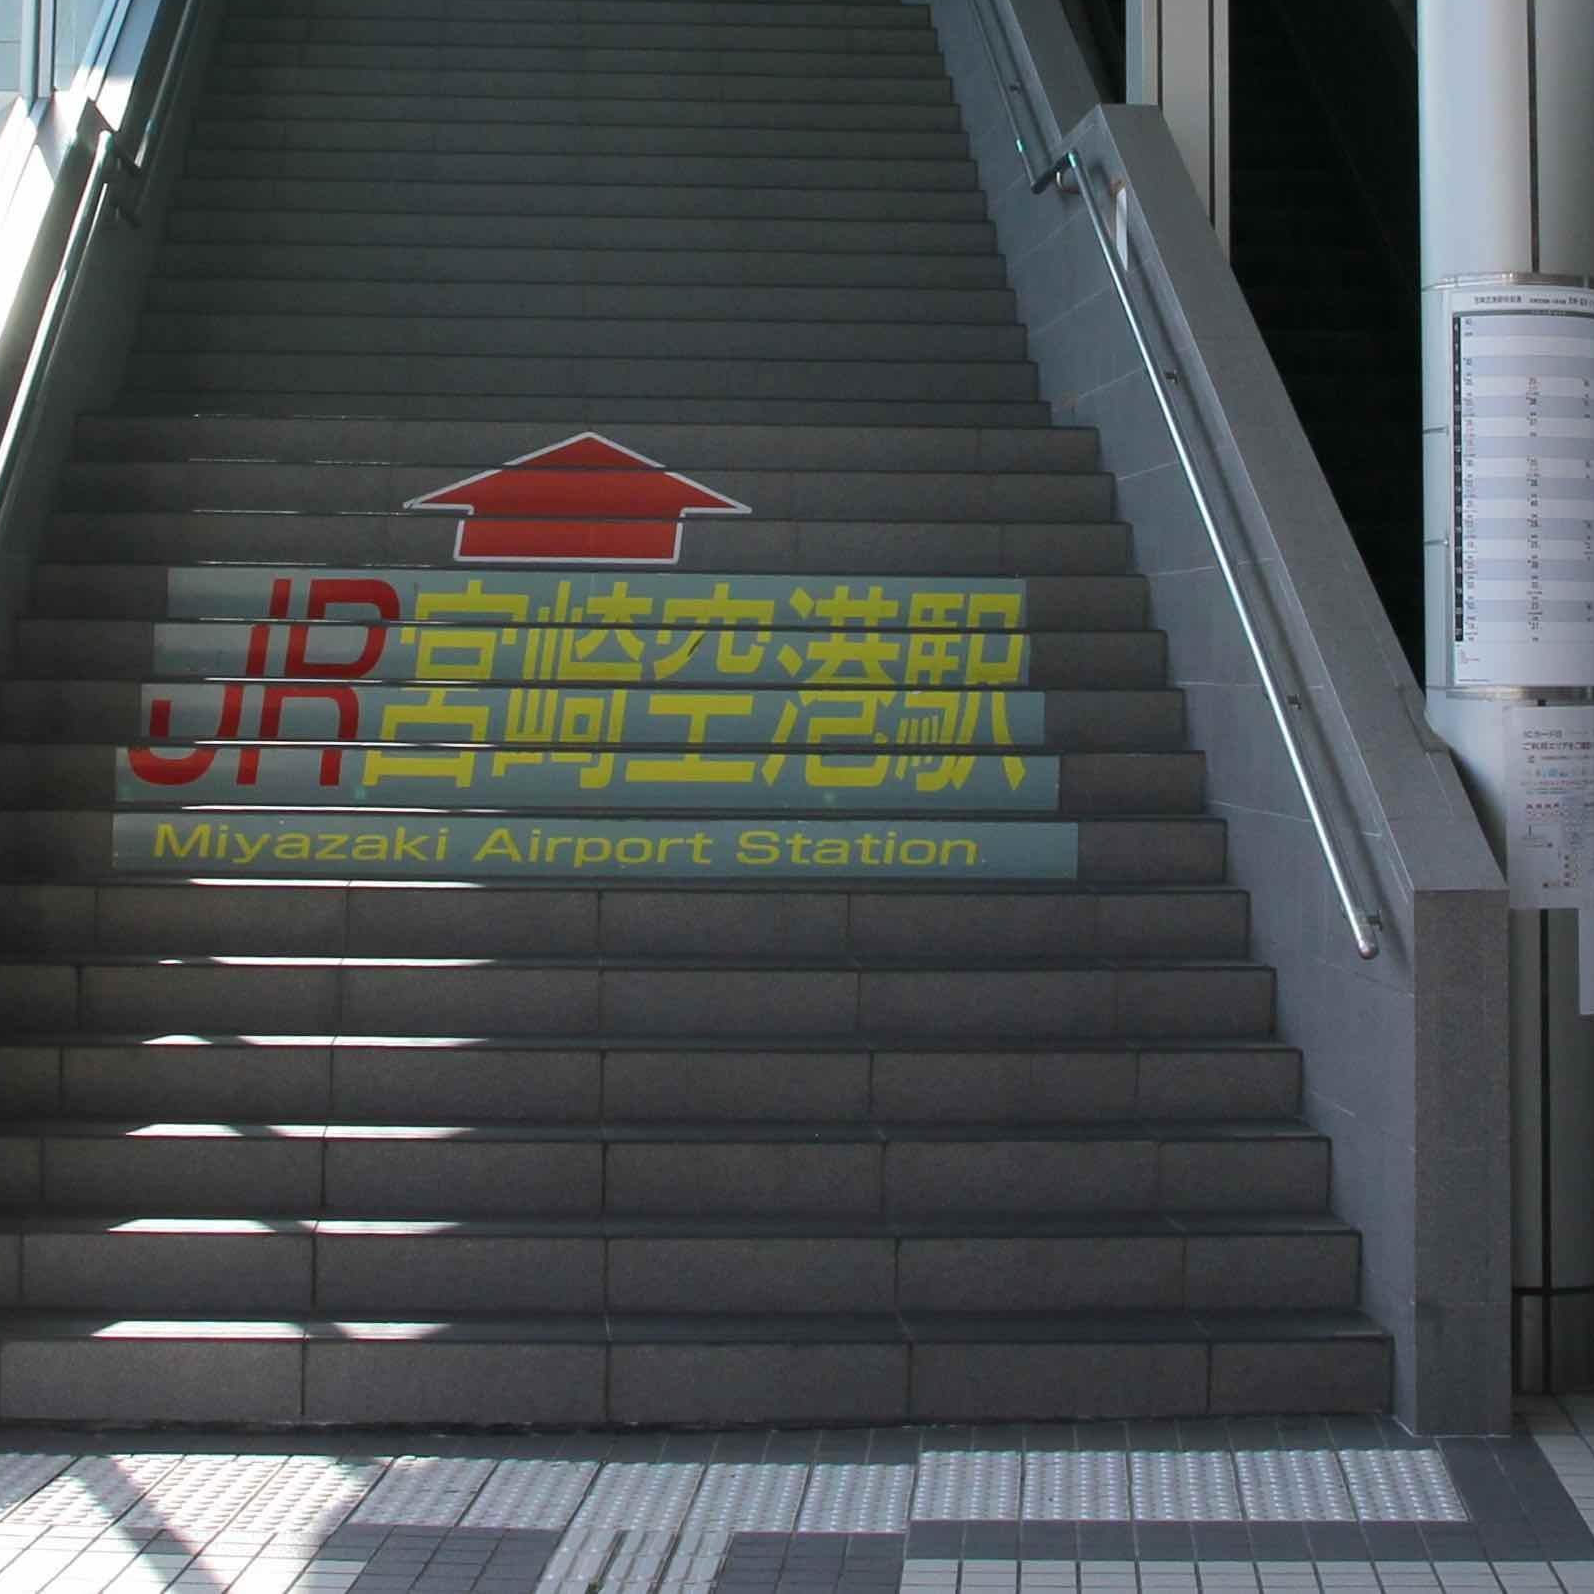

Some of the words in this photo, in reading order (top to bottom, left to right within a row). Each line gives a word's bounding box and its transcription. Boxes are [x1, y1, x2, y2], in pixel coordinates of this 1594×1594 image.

[152, 821, 449, 865] Miyazaki
[473, 827, 712, 868] Airport
[735, 830, 979, 866] Station
